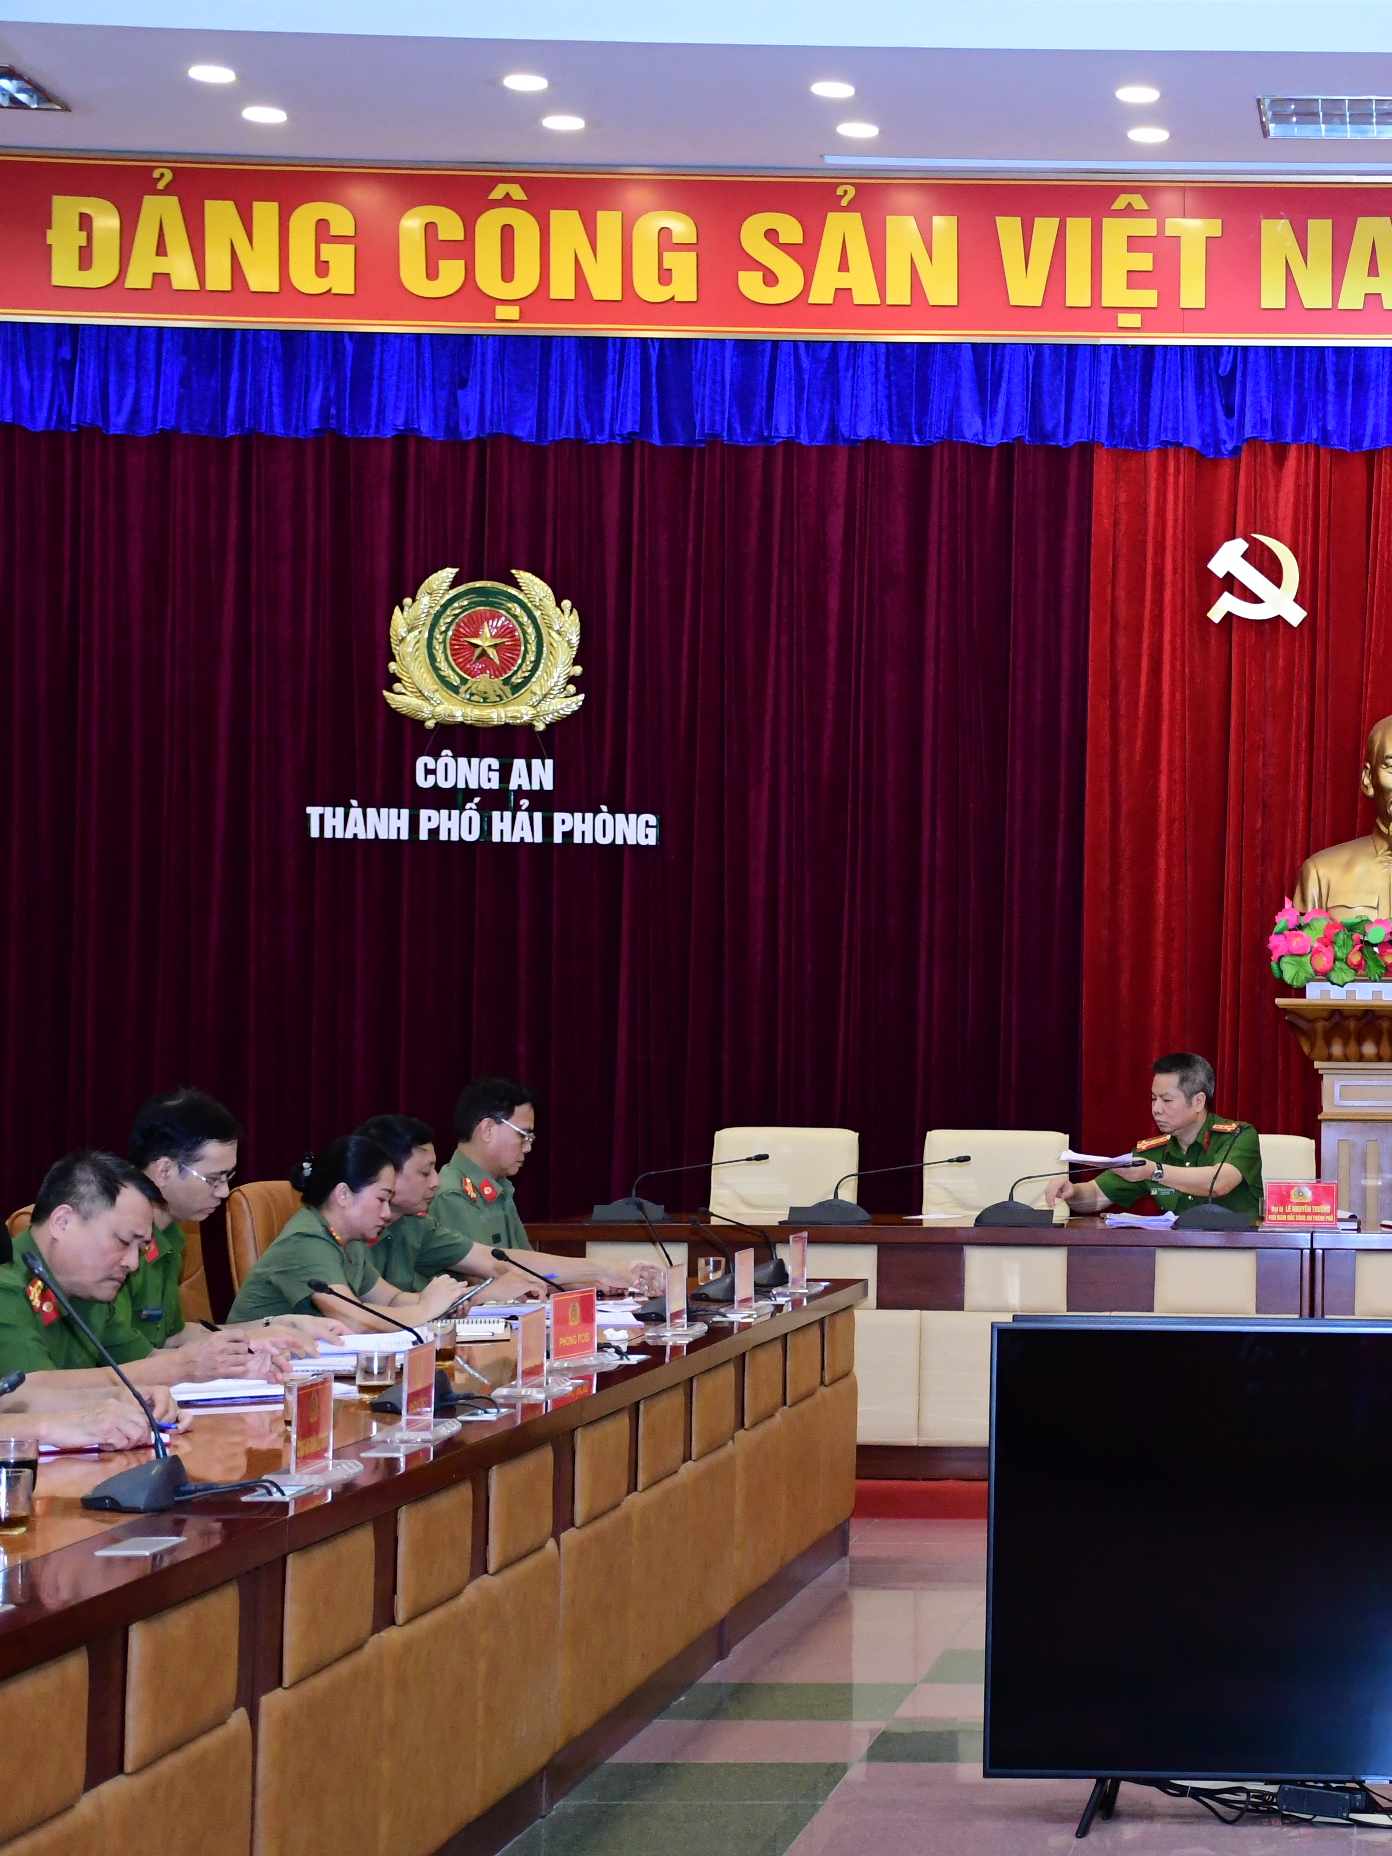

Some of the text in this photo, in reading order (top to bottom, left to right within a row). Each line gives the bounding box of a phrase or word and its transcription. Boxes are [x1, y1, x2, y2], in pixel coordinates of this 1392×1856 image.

[47, 168, 356, 294] ĐẢNG
[399, 183, 698, 321] CỘNG
[738, 183, 972, 306] SẢN
[996, 194, 1222, 327] VIỆT
[416, 750, 554, 790] CÔNG AN
[306, 797, 657, 845] THÀNH PHỐ HẢI PHÒNG
